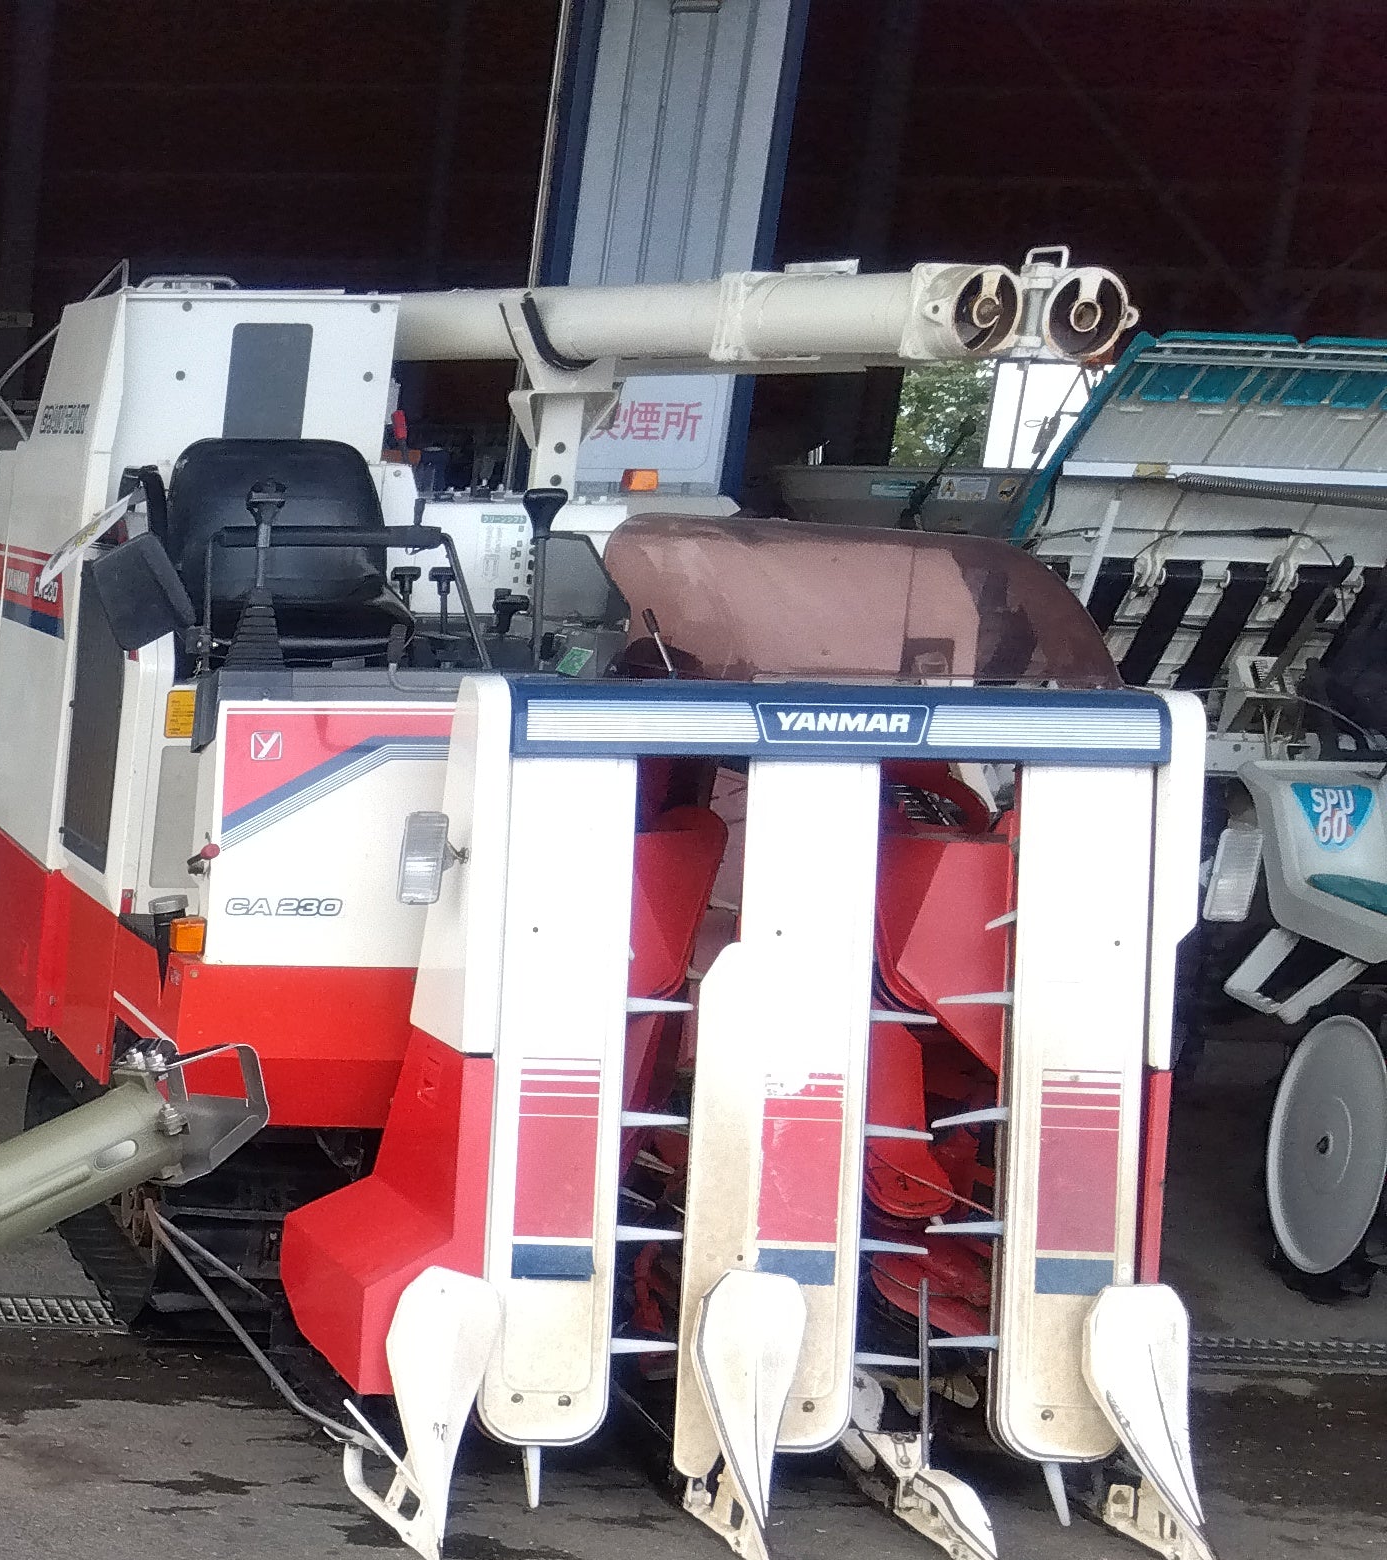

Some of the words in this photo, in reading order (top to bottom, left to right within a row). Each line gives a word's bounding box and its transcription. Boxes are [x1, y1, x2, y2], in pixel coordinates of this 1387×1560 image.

[776, 711, 911, 733] YANMAR
[1310, 787, 1355, 815] SPU
[1319, 808, 1348, 844] 60
[225, 897, 273, 917] CA
[274, 897, 344, 917] 230
